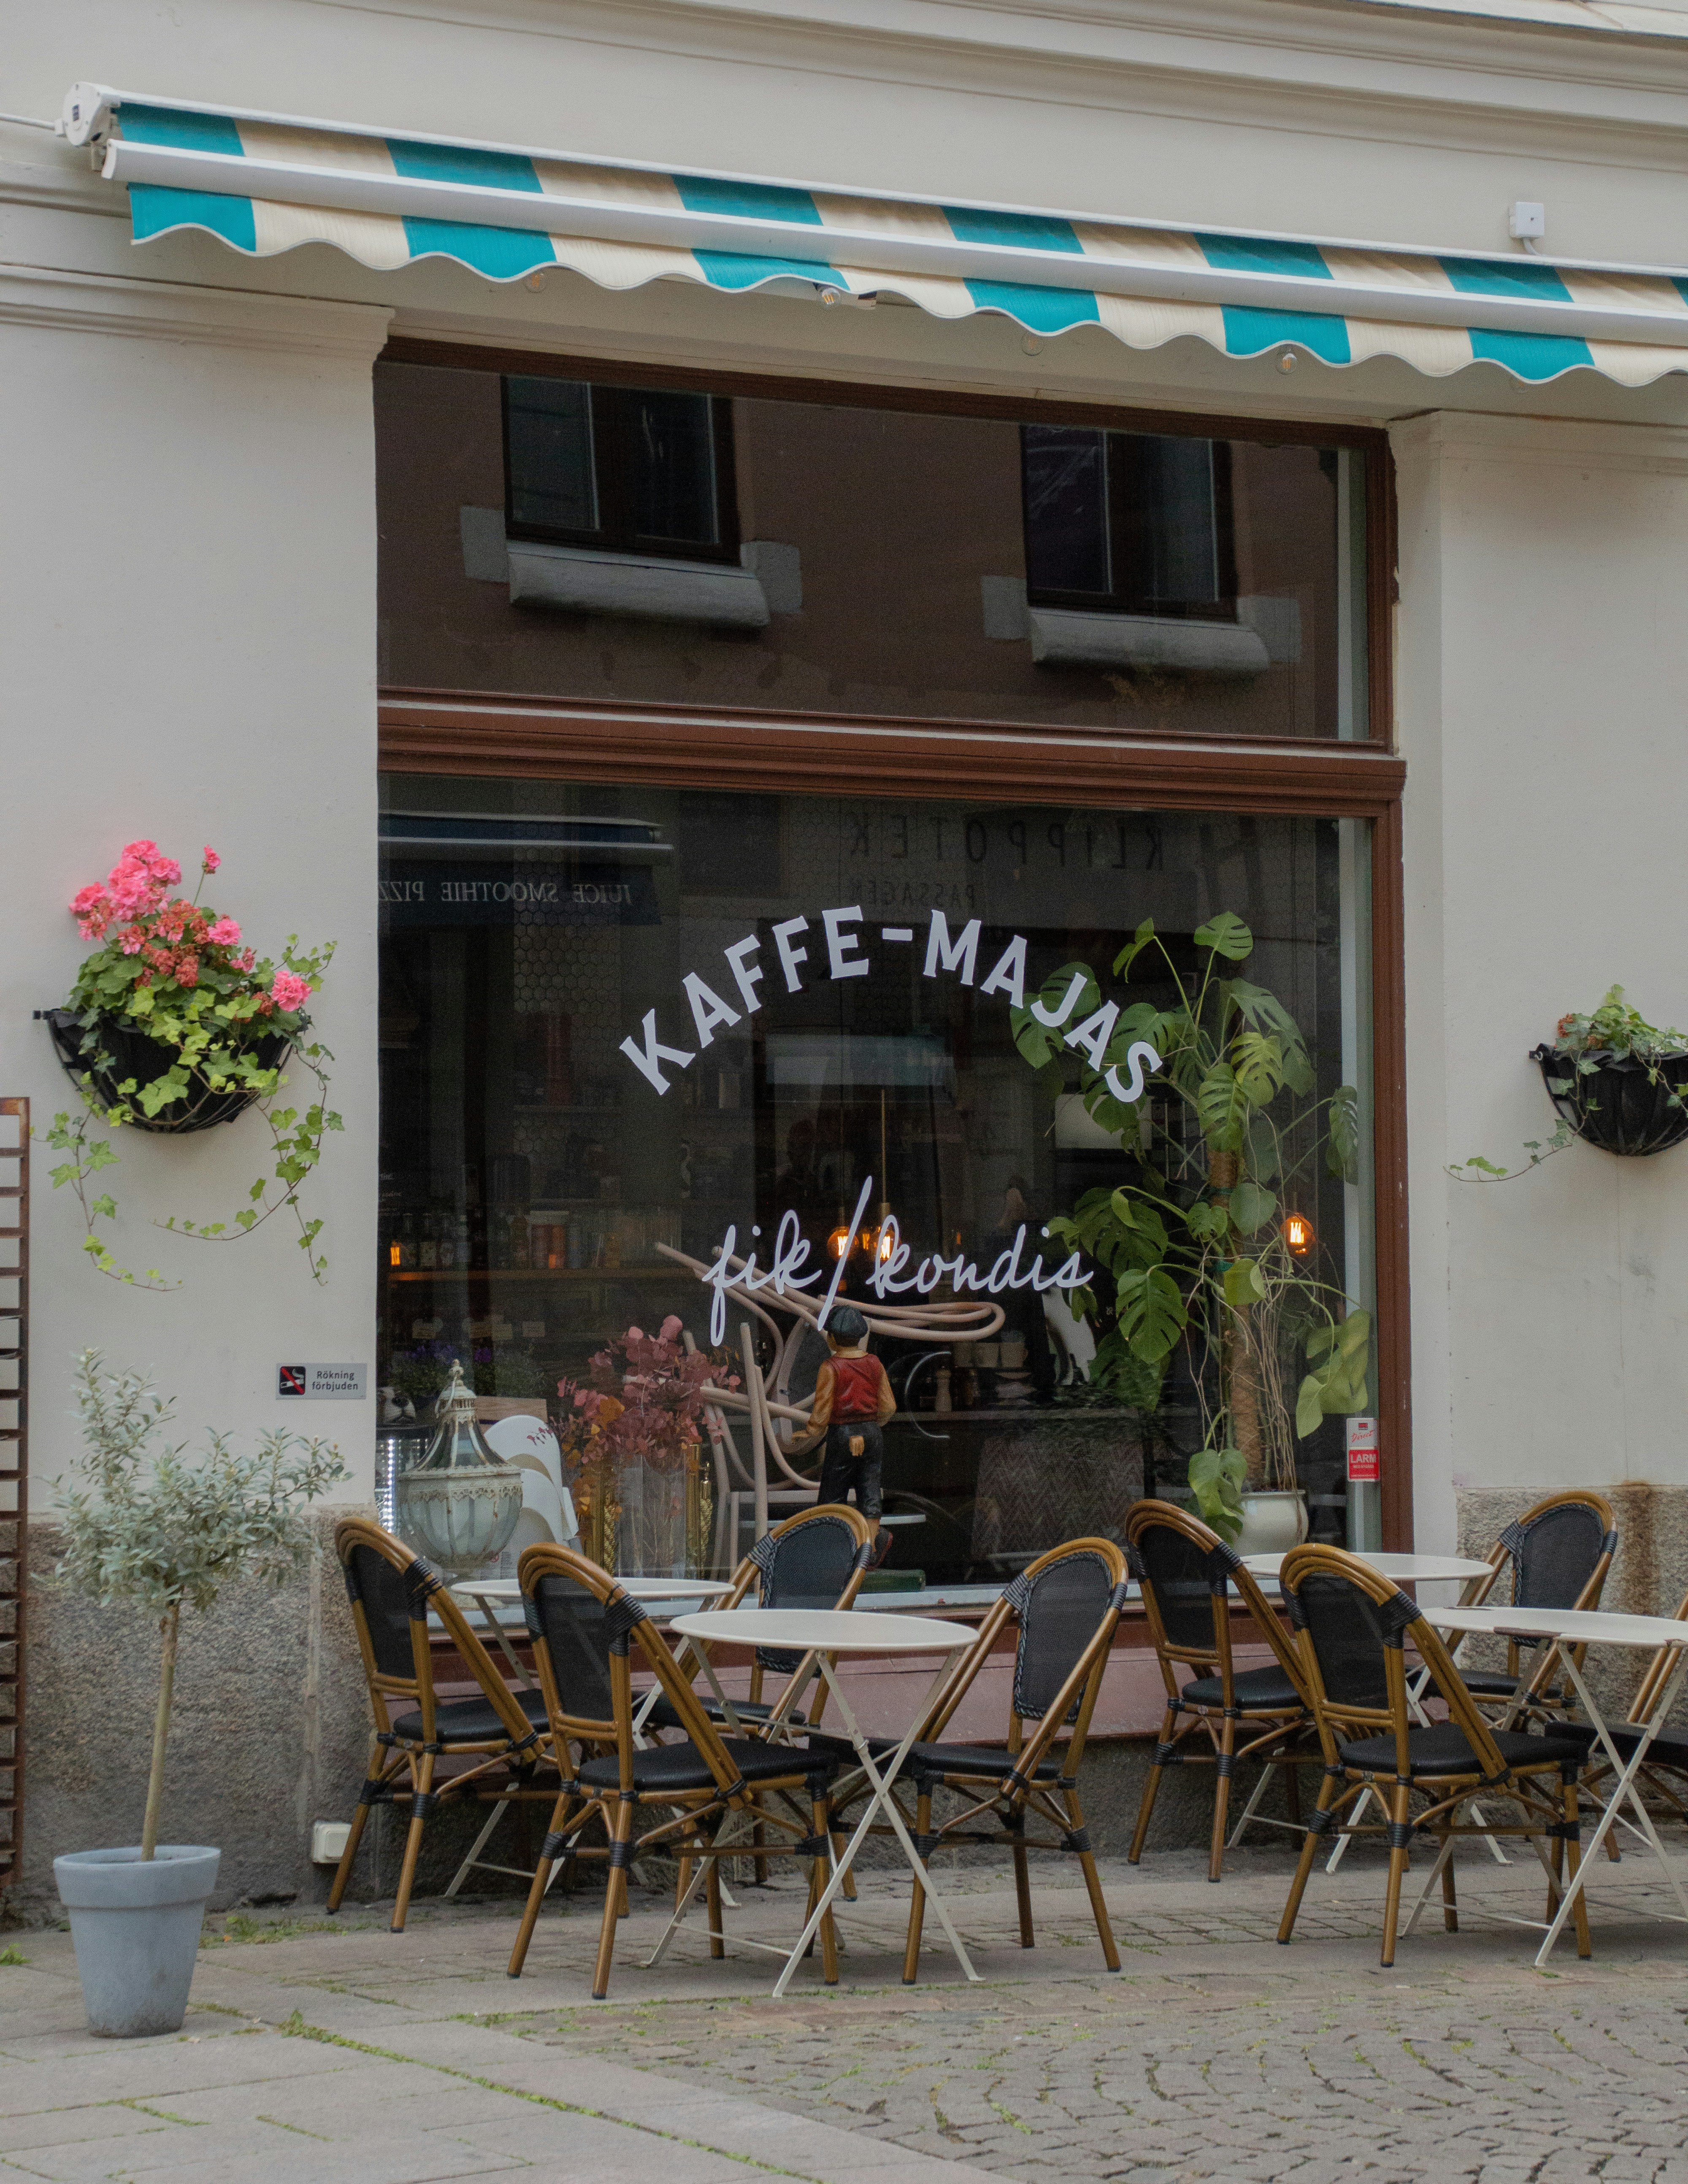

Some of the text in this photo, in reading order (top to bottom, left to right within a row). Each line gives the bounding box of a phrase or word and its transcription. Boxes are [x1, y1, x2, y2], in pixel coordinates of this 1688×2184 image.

[619, 905, 1162, 1102] KAFFE-MAJAS
[317, 1370, 354, 1381] Rökning
[312, 1381, 358, 1392] förbjuden
[1350, 1454, 1377, 1463] LARM
